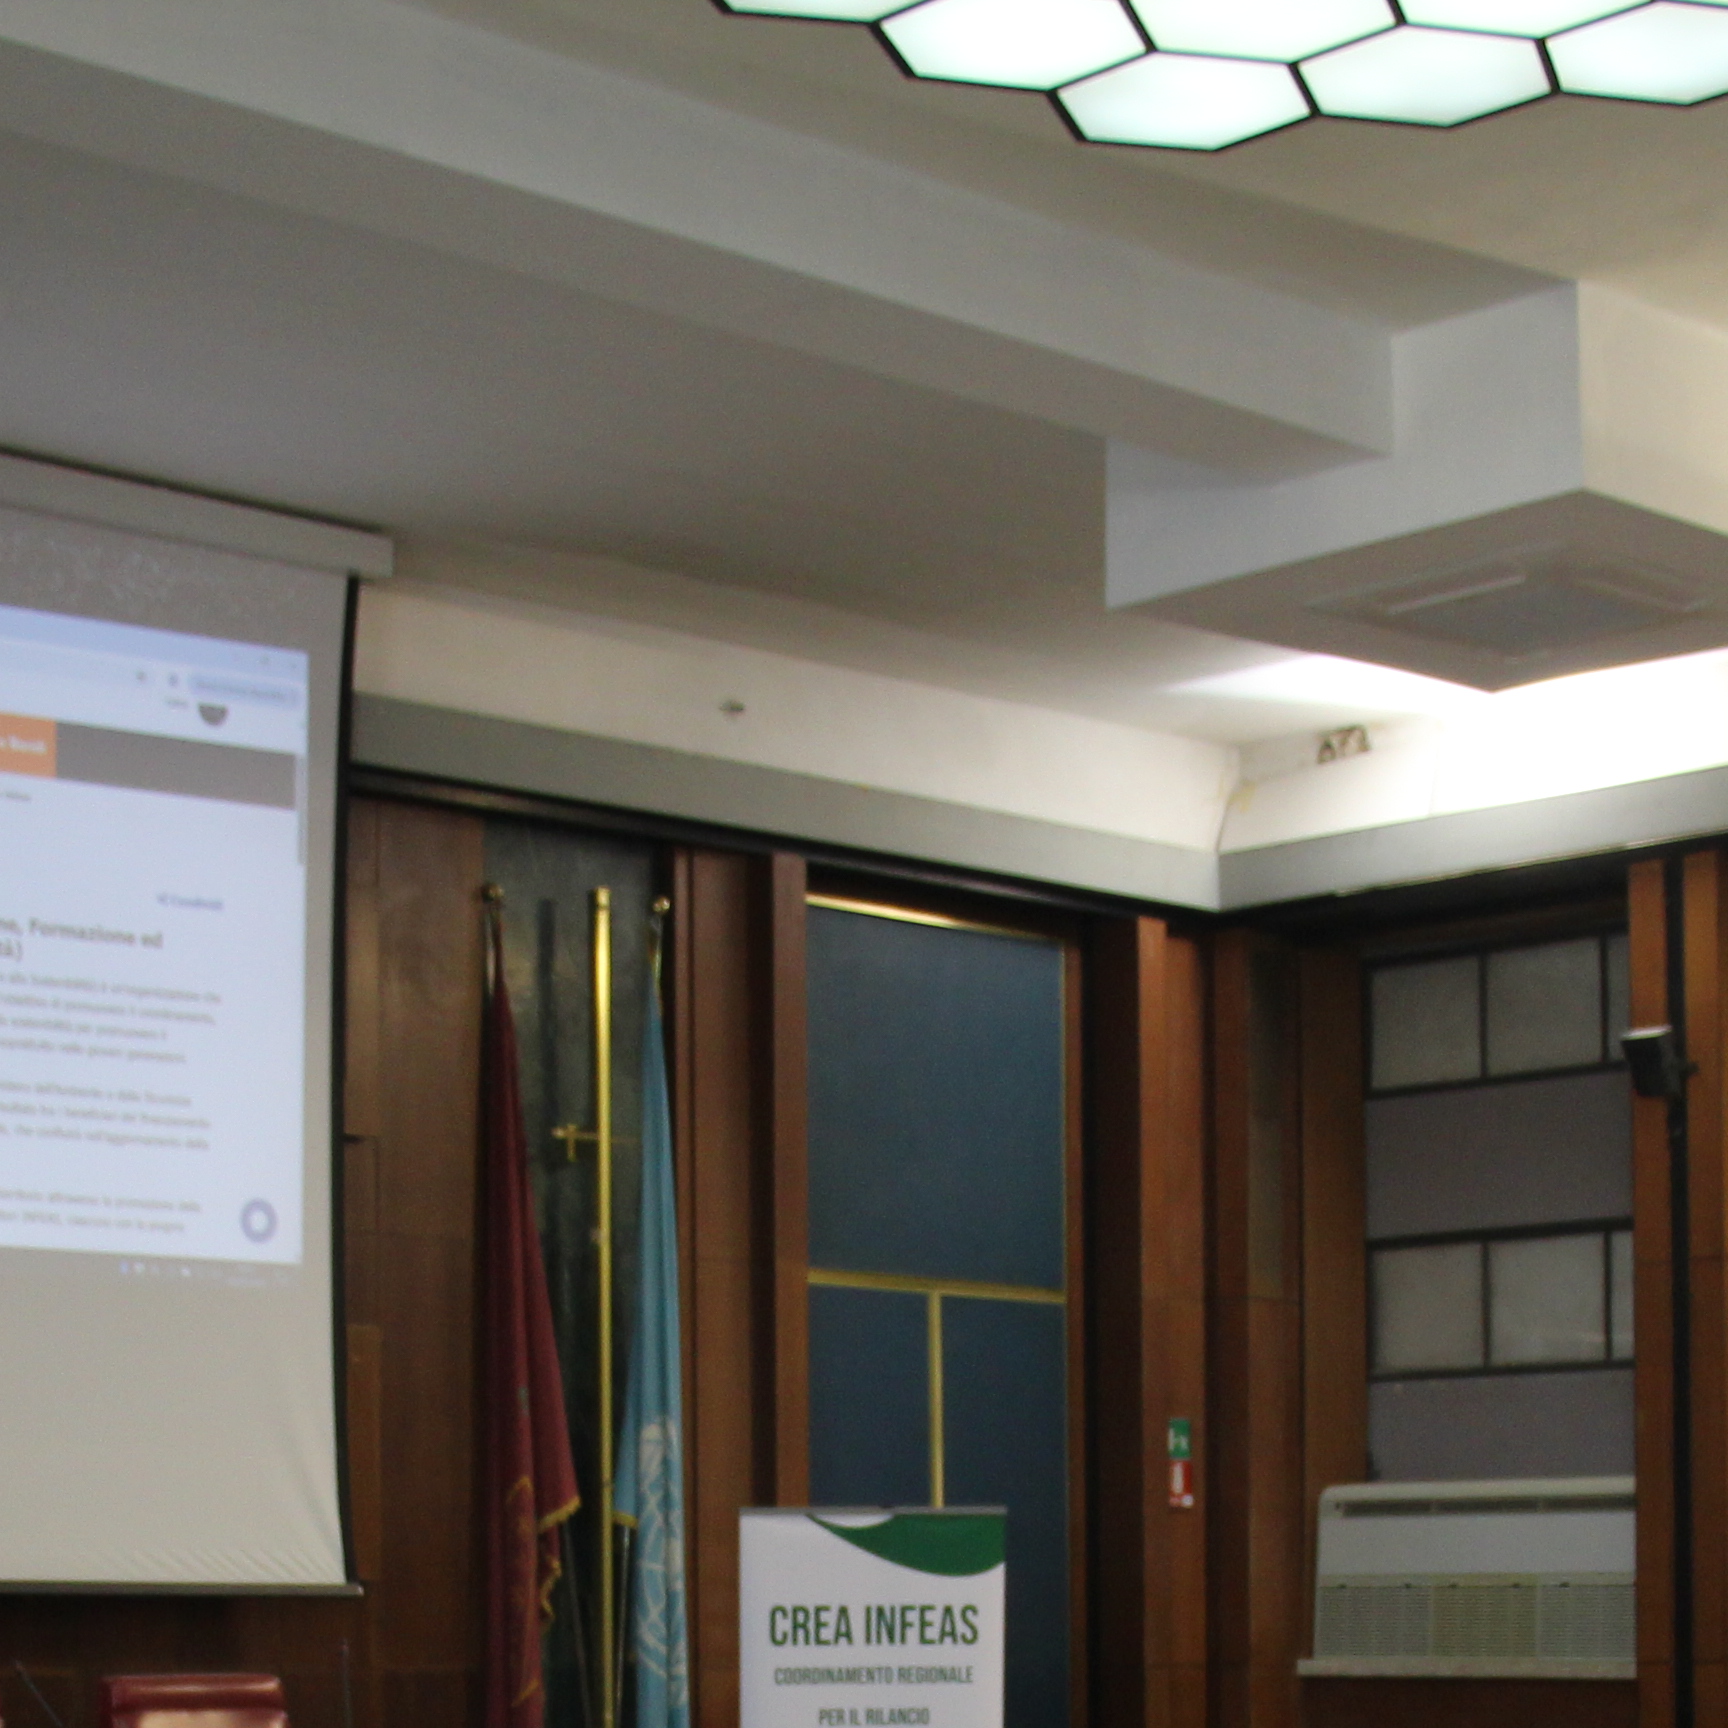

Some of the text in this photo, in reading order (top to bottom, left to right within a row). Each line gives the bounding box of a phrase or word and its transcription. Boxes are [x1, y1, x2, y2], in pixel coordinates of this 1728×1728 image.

[28, 917, 135, 946] Formazione
[140, 930, 163, 949] ed
[769, 1604, 980, 1646] CREA INFEAS
[774, 1665, 974, 1685] COORDINAMENTO REGIONALE
[818, 1707, 930, 1727] PER IL RILANCIO
